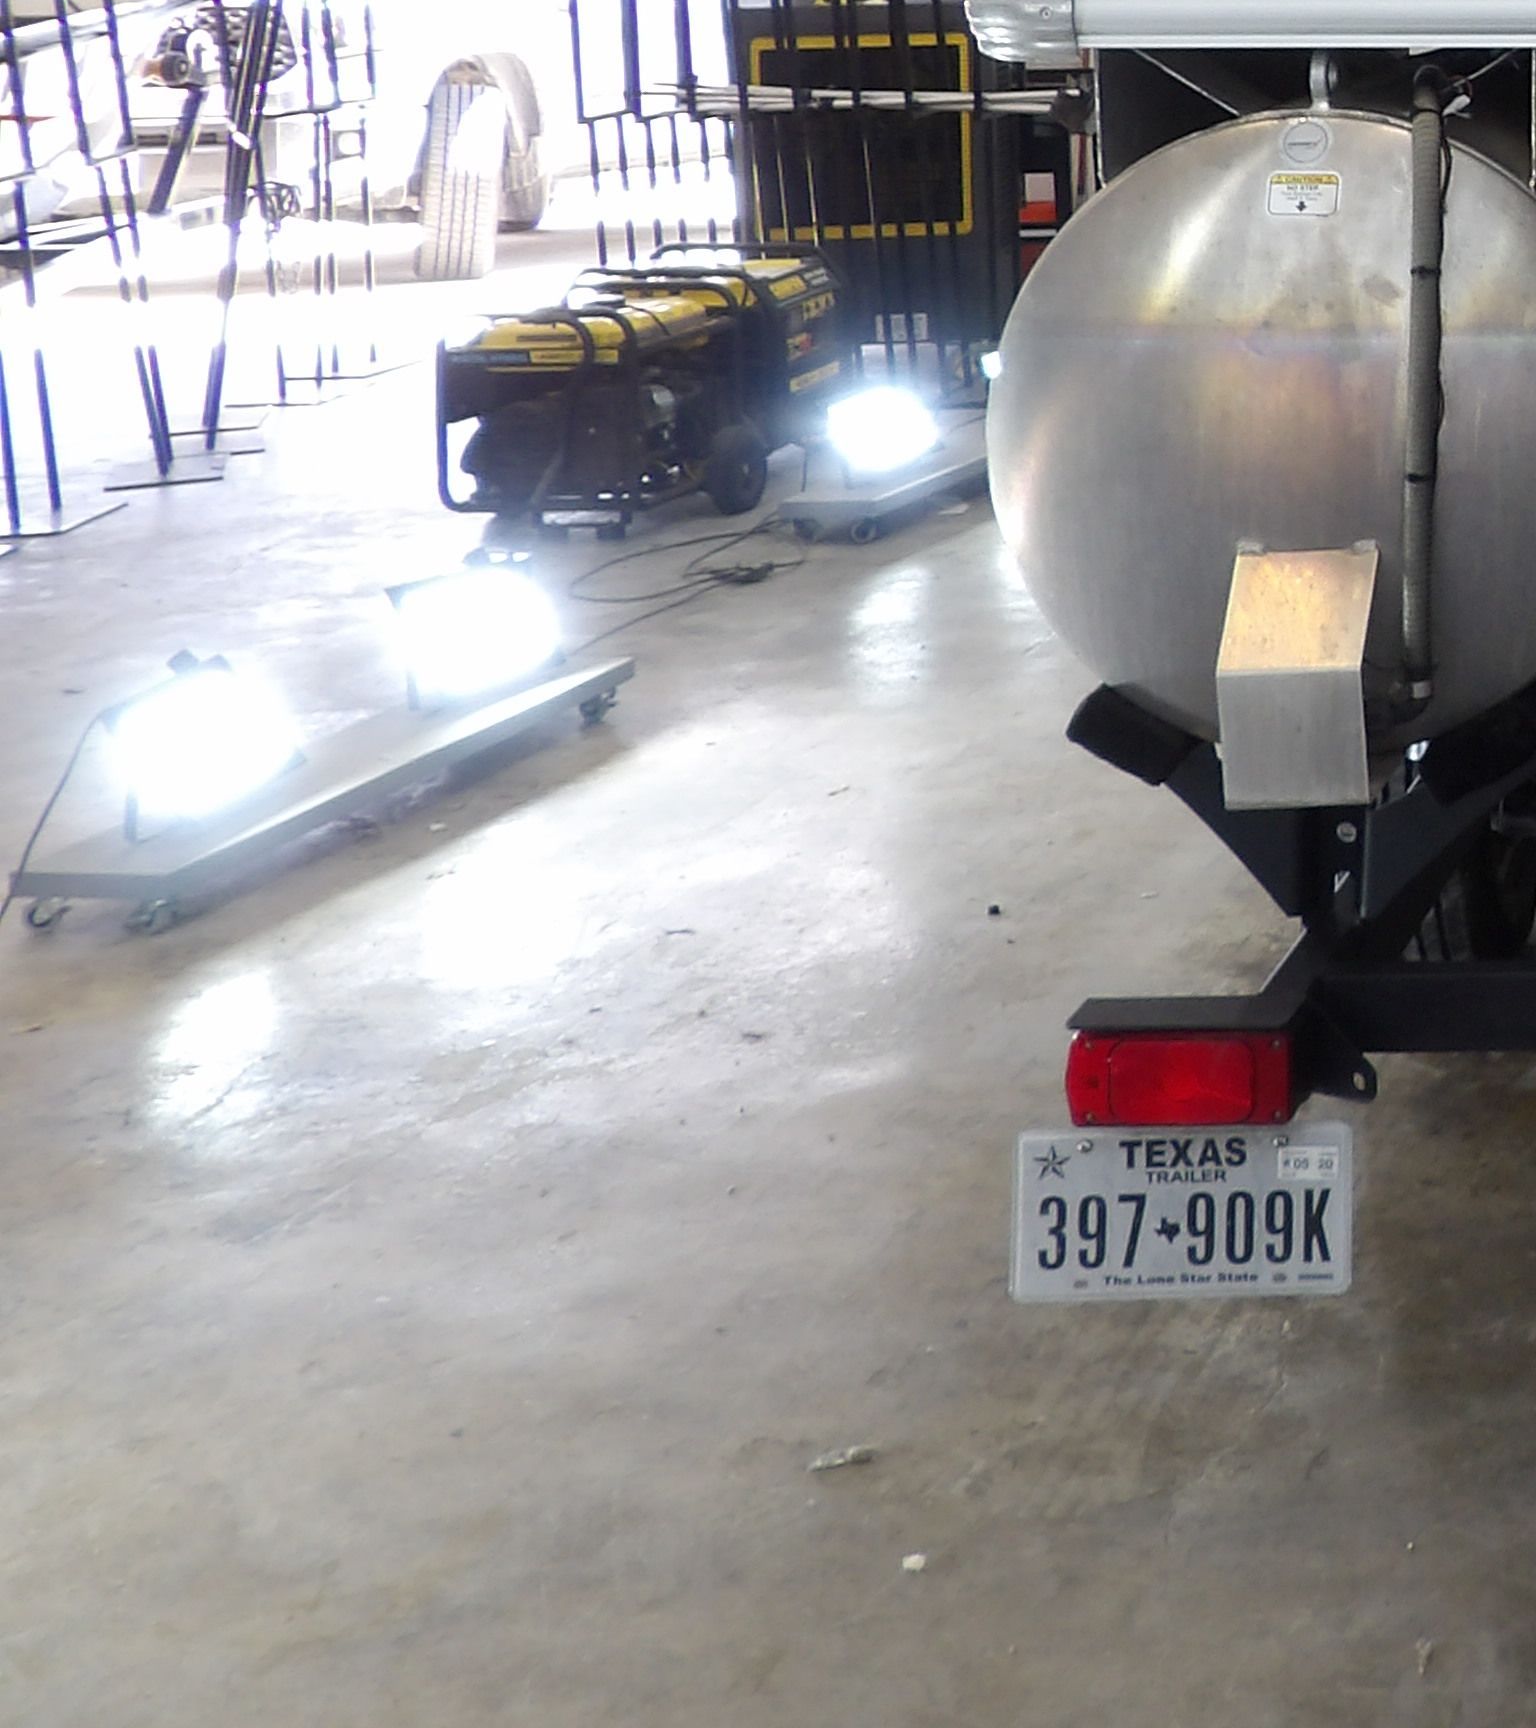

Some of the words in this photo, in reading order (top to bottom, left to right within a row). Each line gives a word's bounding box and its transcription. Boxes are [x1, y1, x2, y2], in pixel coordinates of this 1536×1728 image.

[1119, 1137, 1247, 1169] TEXAS
[1146, 1171, 1226, 1184] TRAILER
[1104, 1274, 1135, 1286] The
[1137, 1274, 1175, 1285] Lone
[1180, 1273, 1213, 1284] Star
[1218, 1272, 1259, 1283] State
